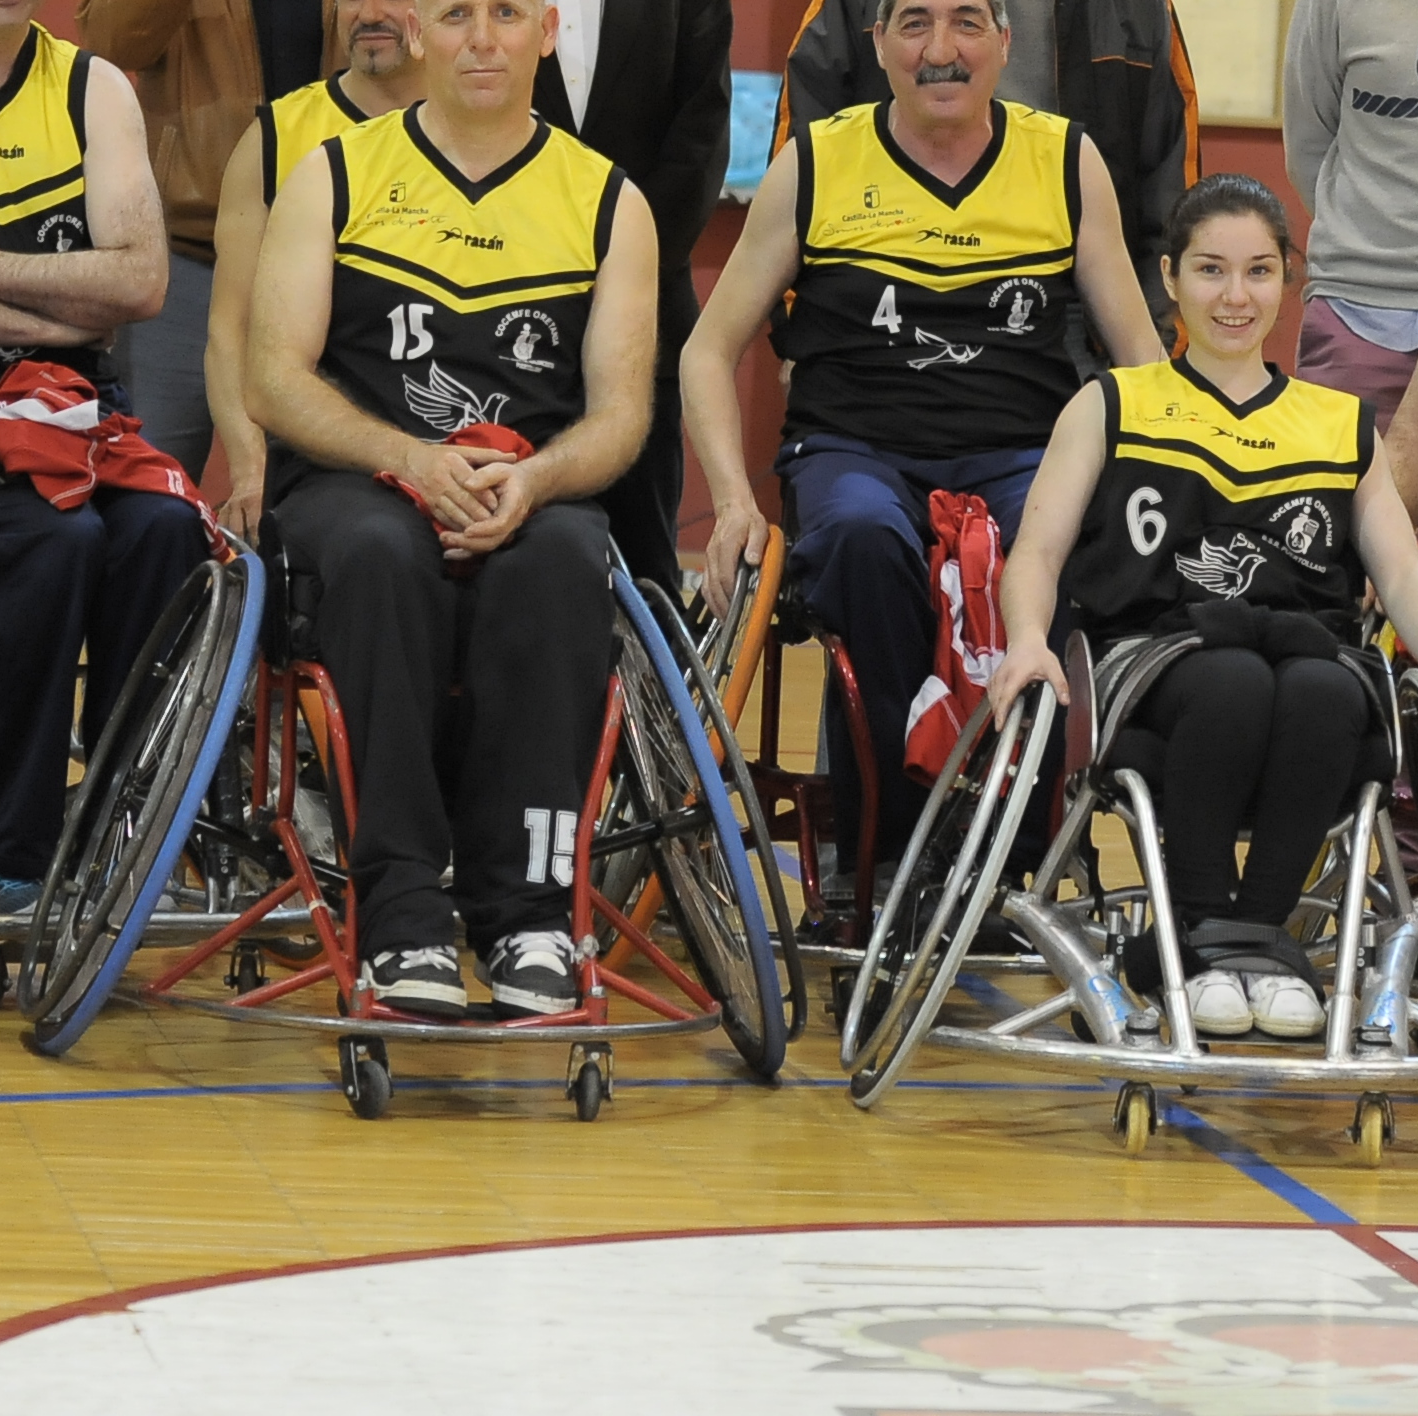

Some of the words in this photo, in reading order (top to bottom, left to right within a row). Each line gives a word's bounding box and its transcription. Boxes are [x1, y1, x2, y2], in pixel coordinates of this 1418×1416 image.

[464, 234, 505, 251] rasán
[943, 232, 981, 248] rasán
[386, 303, 434, 361] 15
[871, 284, 903, 334] 4
[1235, 437, 1277, 451] rasán
[1126, 486, 1168, 557] 6
[524, 807, 578, 888] 15
